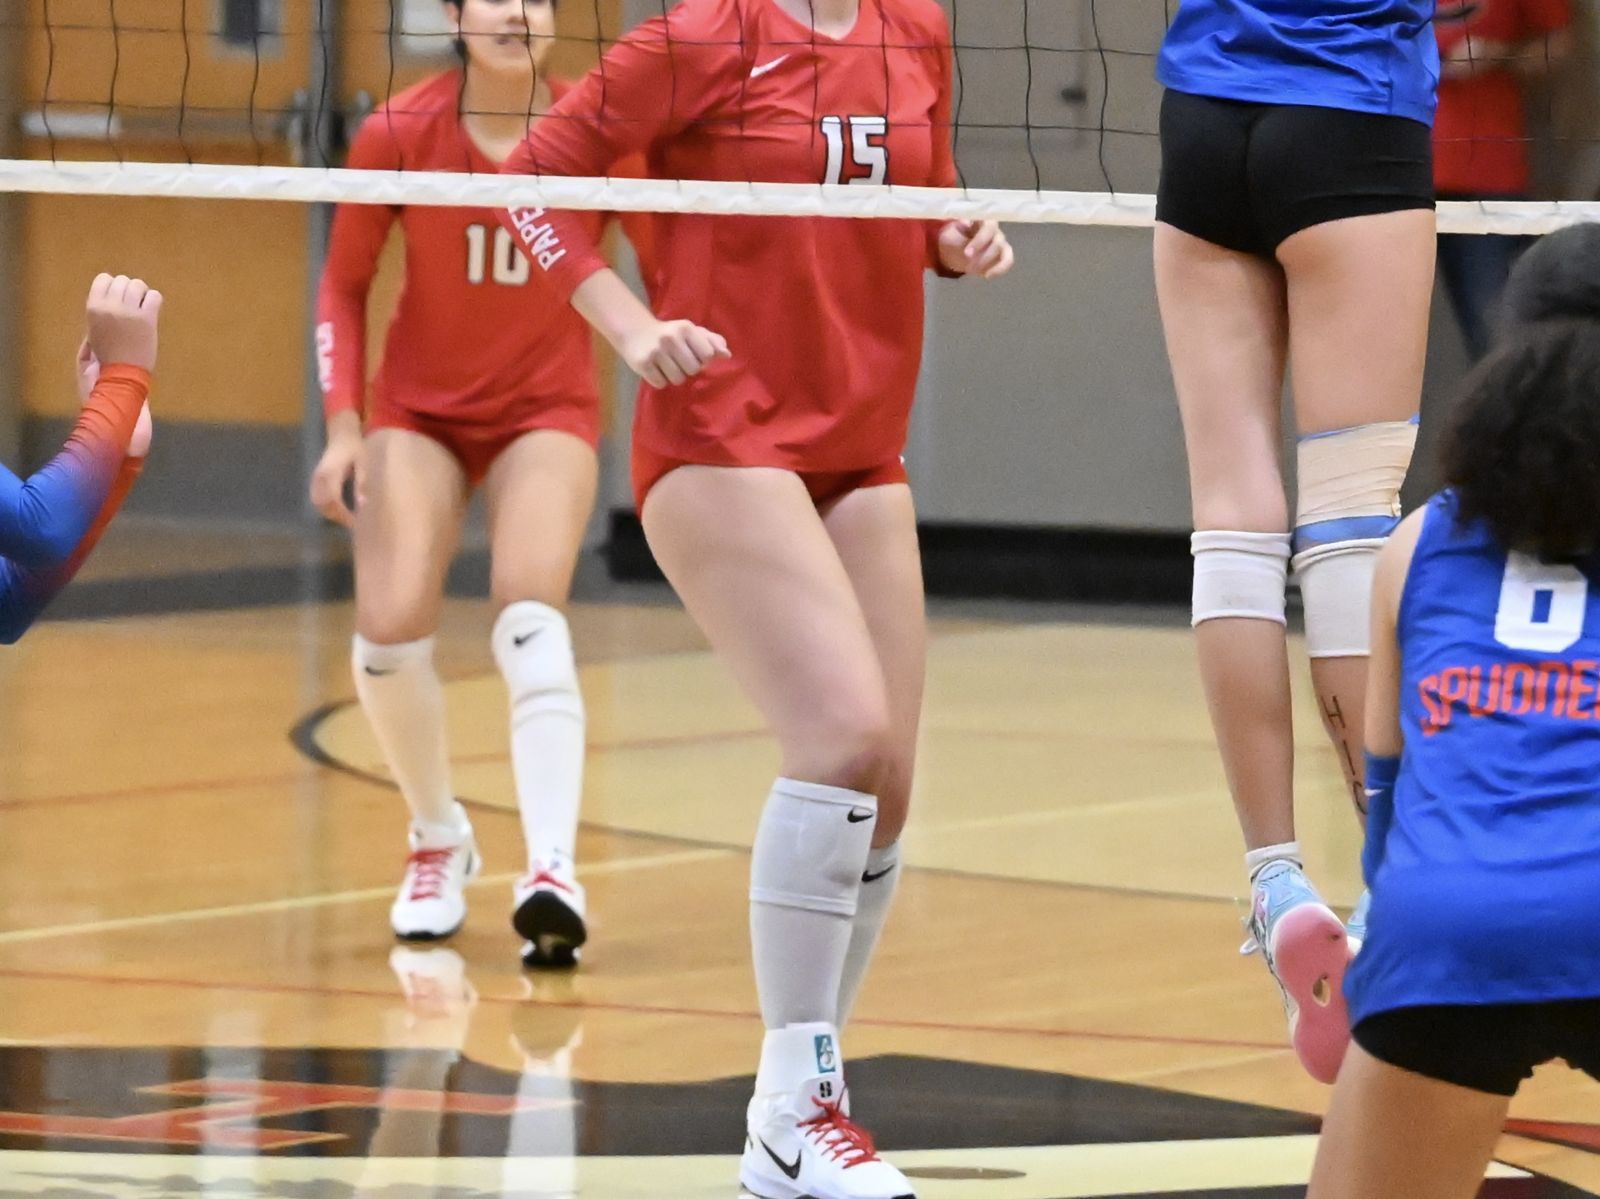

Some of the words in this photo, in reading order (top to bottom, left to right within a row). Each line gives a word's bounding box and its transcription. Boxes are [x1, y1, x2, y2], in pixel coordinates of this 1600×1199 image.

[820, 114, 889, 185] 15
[465, 223, 530, 287] 10
[1494, 549, 1587, 653] 6
